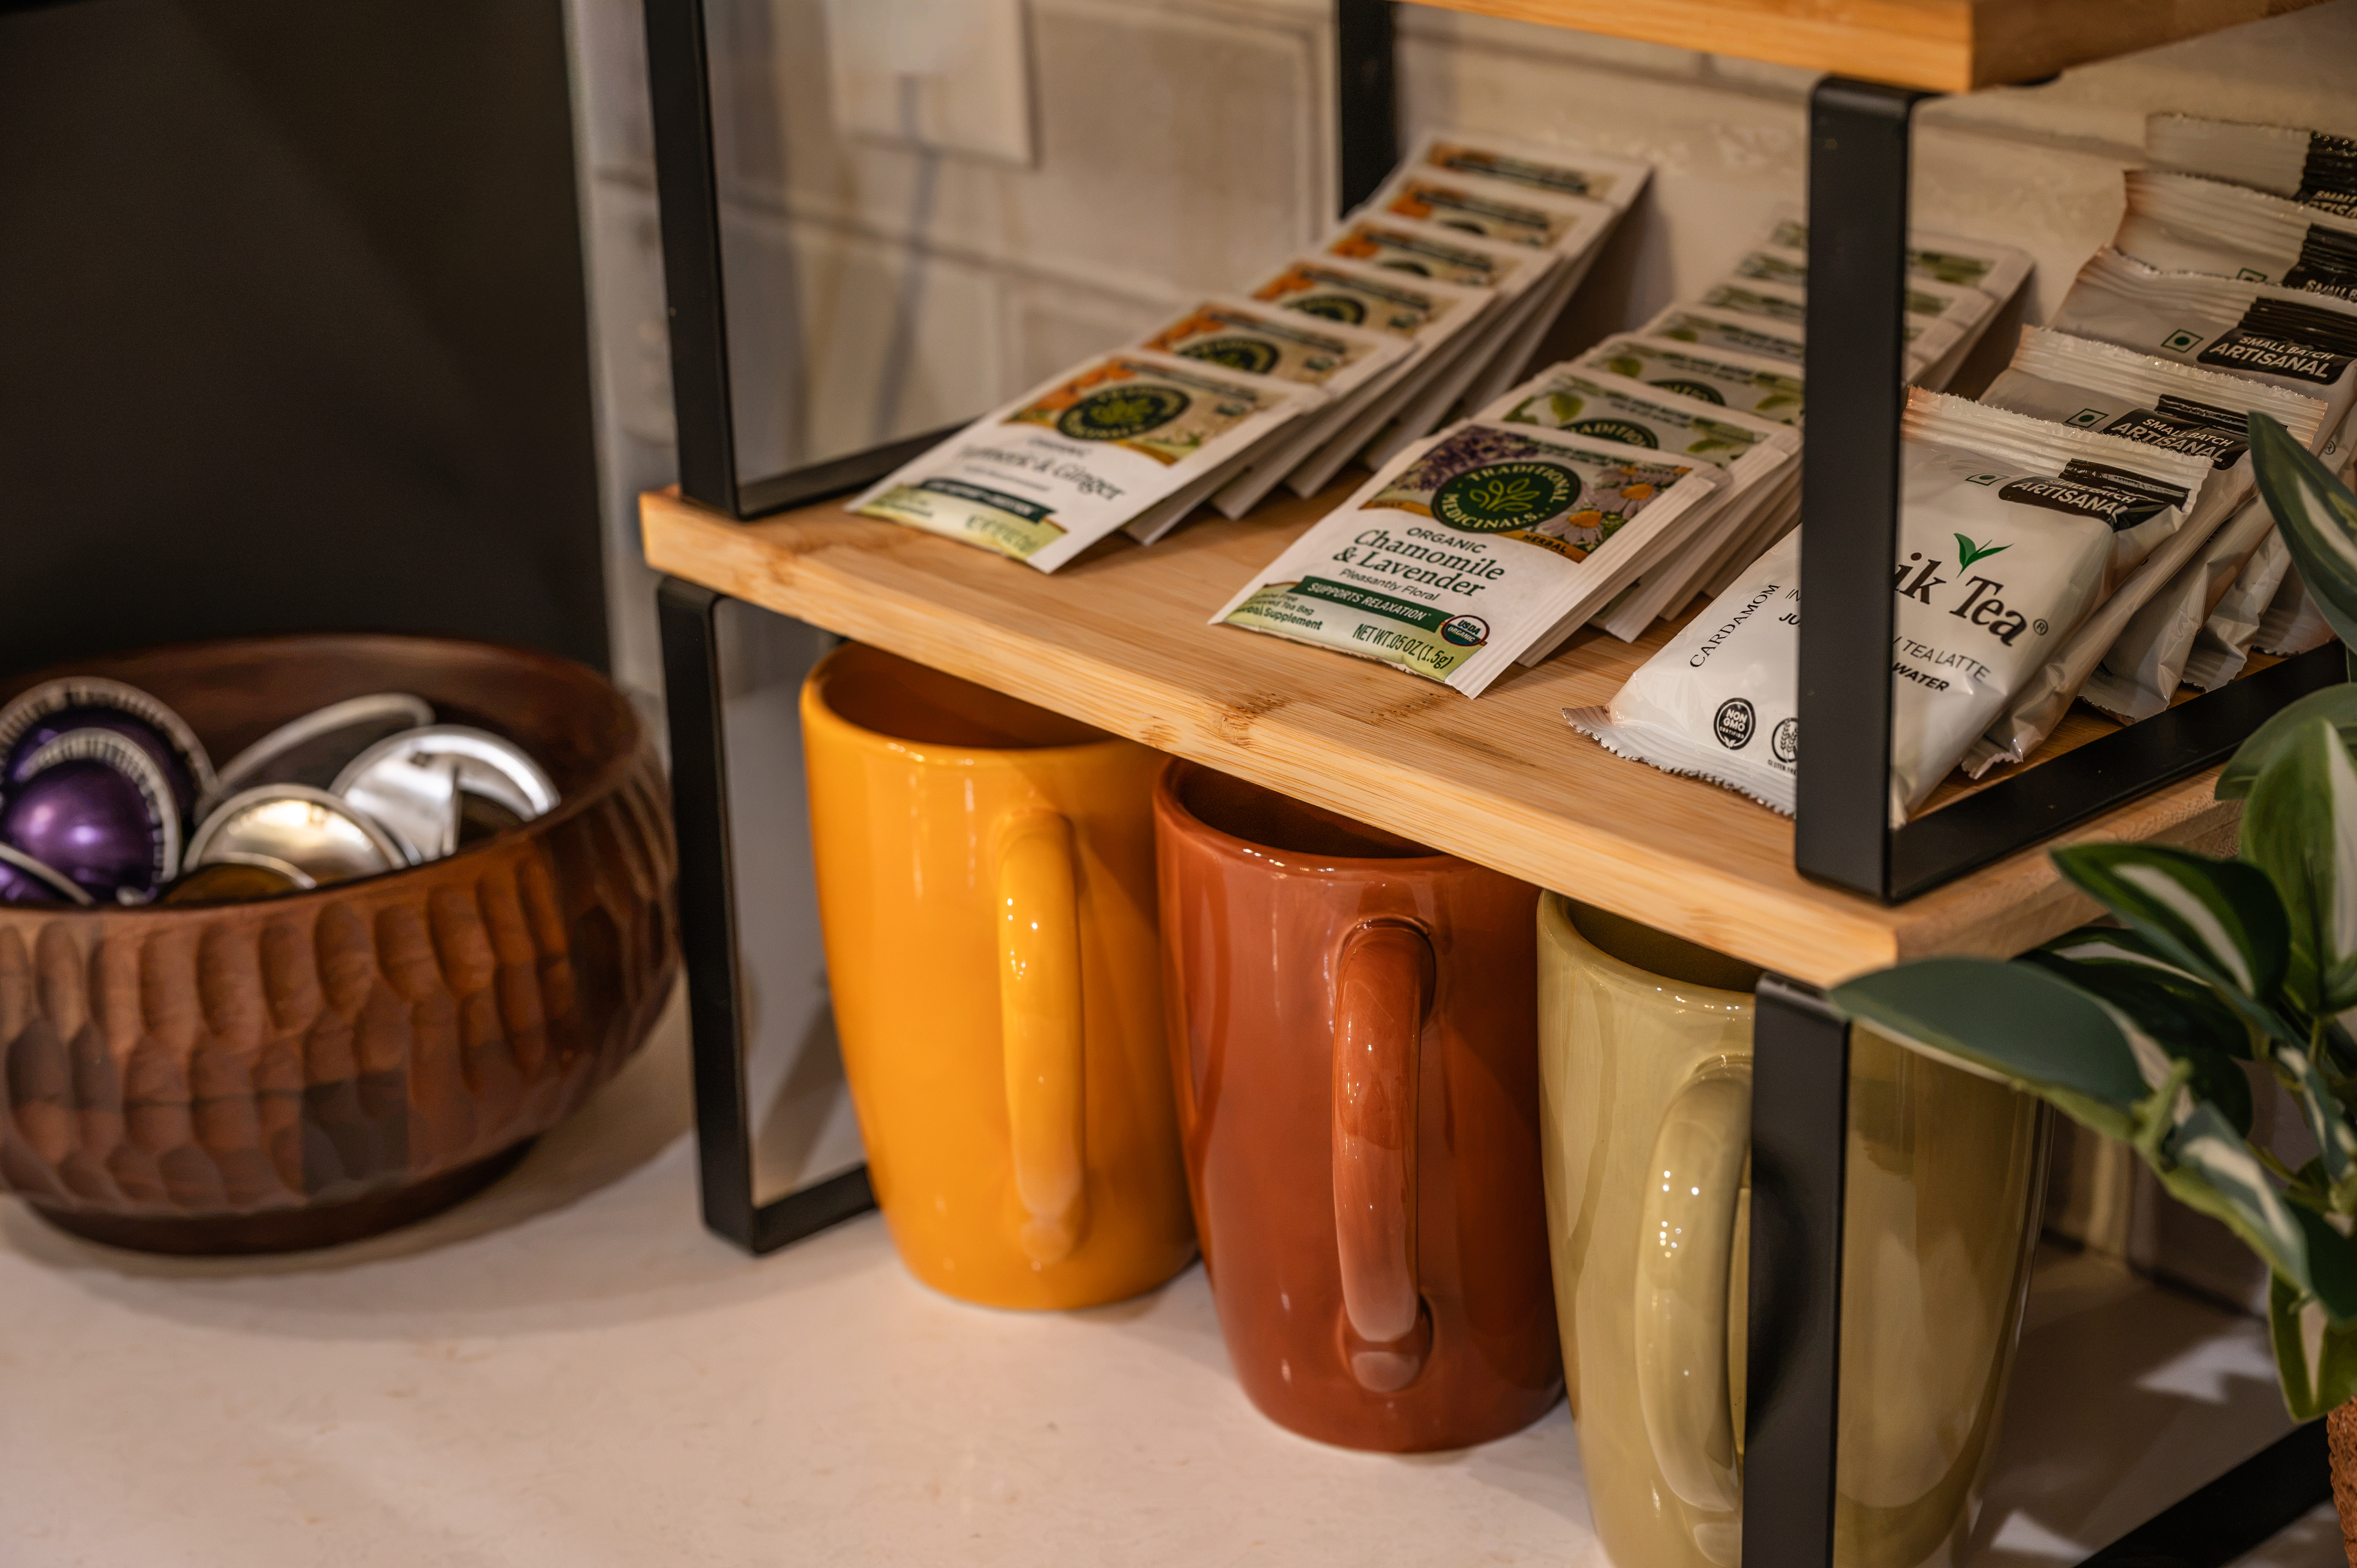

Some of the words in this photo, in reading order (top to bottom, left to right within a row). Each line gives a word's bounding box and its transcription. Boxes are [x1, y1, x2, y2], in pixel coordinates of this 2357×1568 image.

[2209, 343, 2330, 378] ARTISANAL
[2239, 337, 2285, 353] SMALL
[2286, 346, 2335, 360] BATCH
[2111, 423, 2226, 462] ARTISANAL
[2142, 419, 2185, 437] SMALL
[2187, 432, 2234, 447] BATCH
[1465, 465, 1571, 503] TRADITIONAL
[1442, 493, 1538, 528] MEDICINALS
[1353, 528, 1505, 580] Chamomile
[1406, 527, 1488, 554] ORGANIC
[1522, 534, 1568, 554] HERBAL
[1332, 546, 1357, 562] &
[1357, 551, 1486, 597] Lavender
[1339, 568, 1403, 592] Pleasantly
[1401, 585, 1441, 601] Floral
[1307, 583, 1364, 603] SUPPORTS
[1264, 607, 1323, 630] Supplement
[1296, 605, 1315, 616] Bag
[1352, 623, 1378, 641] NET
[1447, 626, 1475, 643] ORGANIC
[1457, 619, 1481, 636] USDA
[1690, 584, 1781, 667] CARDAMOM
[1902, 639, 1935, 662] TEA
[1935, 650, 1991, 683] LATTE
[1892, 662, 1950, 691] WATER
[1723, 717, 1746, 732] GMO
[1726, 708, 1748, 724] NON
